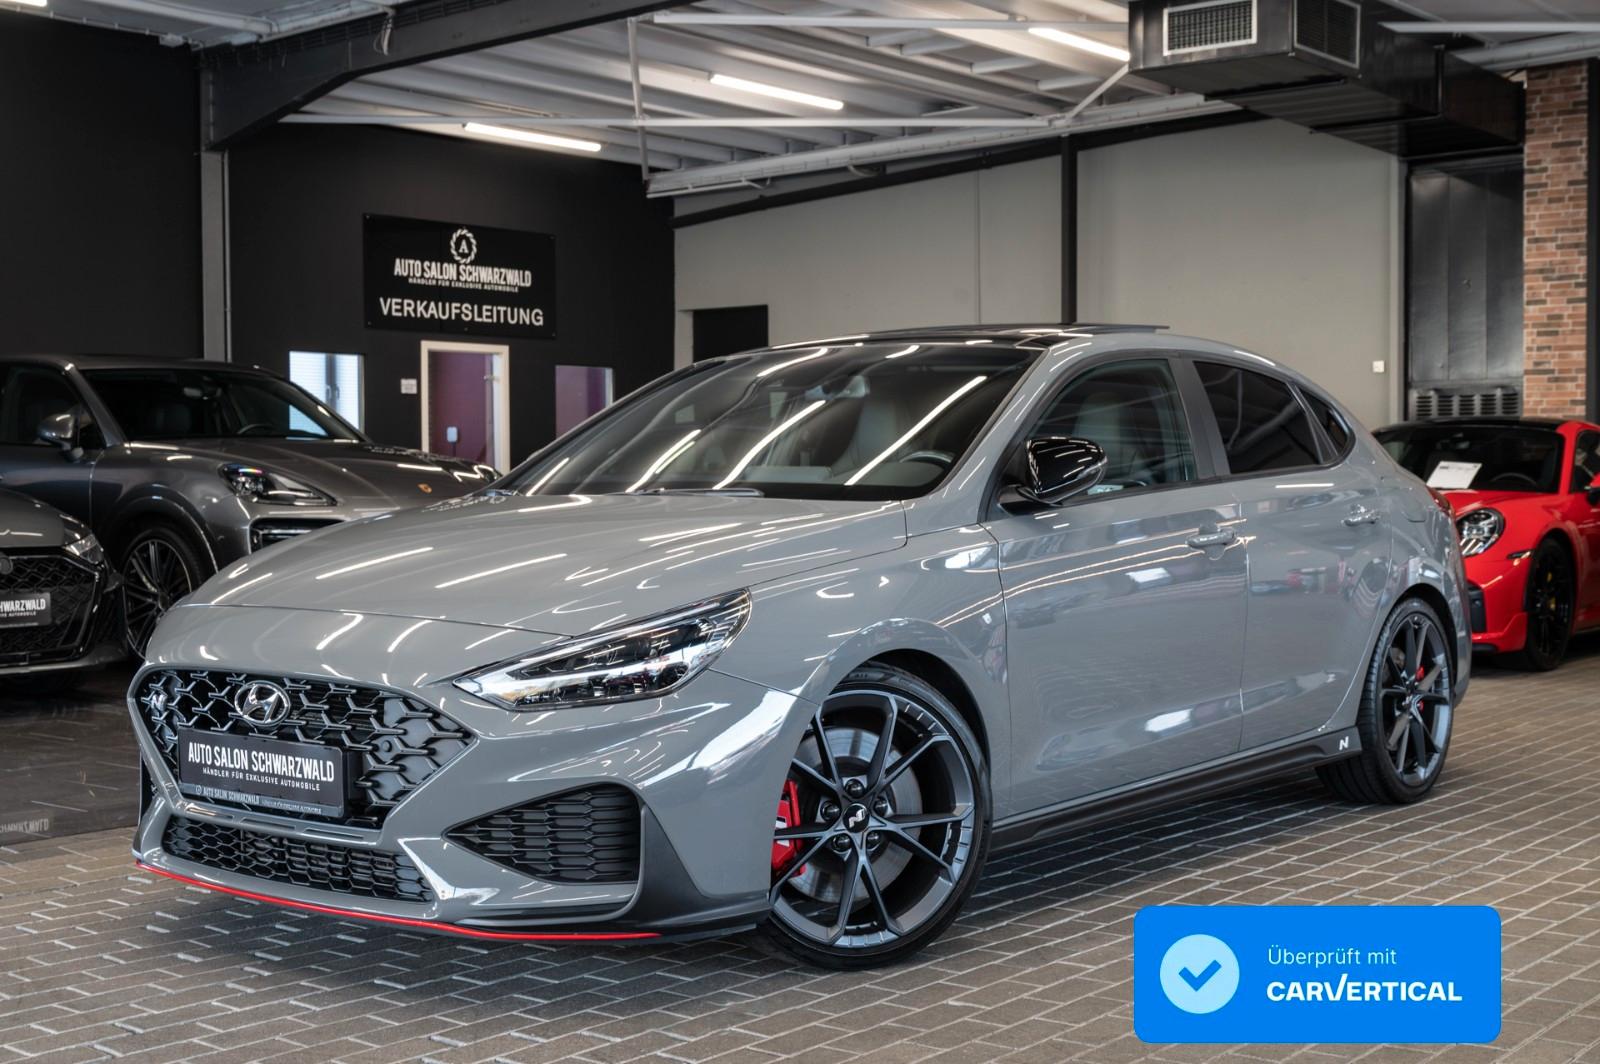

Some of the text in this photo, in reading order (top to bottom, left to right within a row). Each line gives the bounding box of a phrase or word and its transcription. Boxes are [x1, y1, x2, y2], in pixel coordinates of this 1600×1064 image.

[394, 258, 532, 287] AUTO SALON SCHWARZWALD
[379, 297, 544, 326] VERKAUFSLEITUNG
[1339, 736, 1349, 750] N
[188, 742, 335, 782] AUTO SALON SCHWARZWALD
[203, 767, 321, 791] HÄNDLER FÜR EXKLUSIVE AUTOMOBILE
